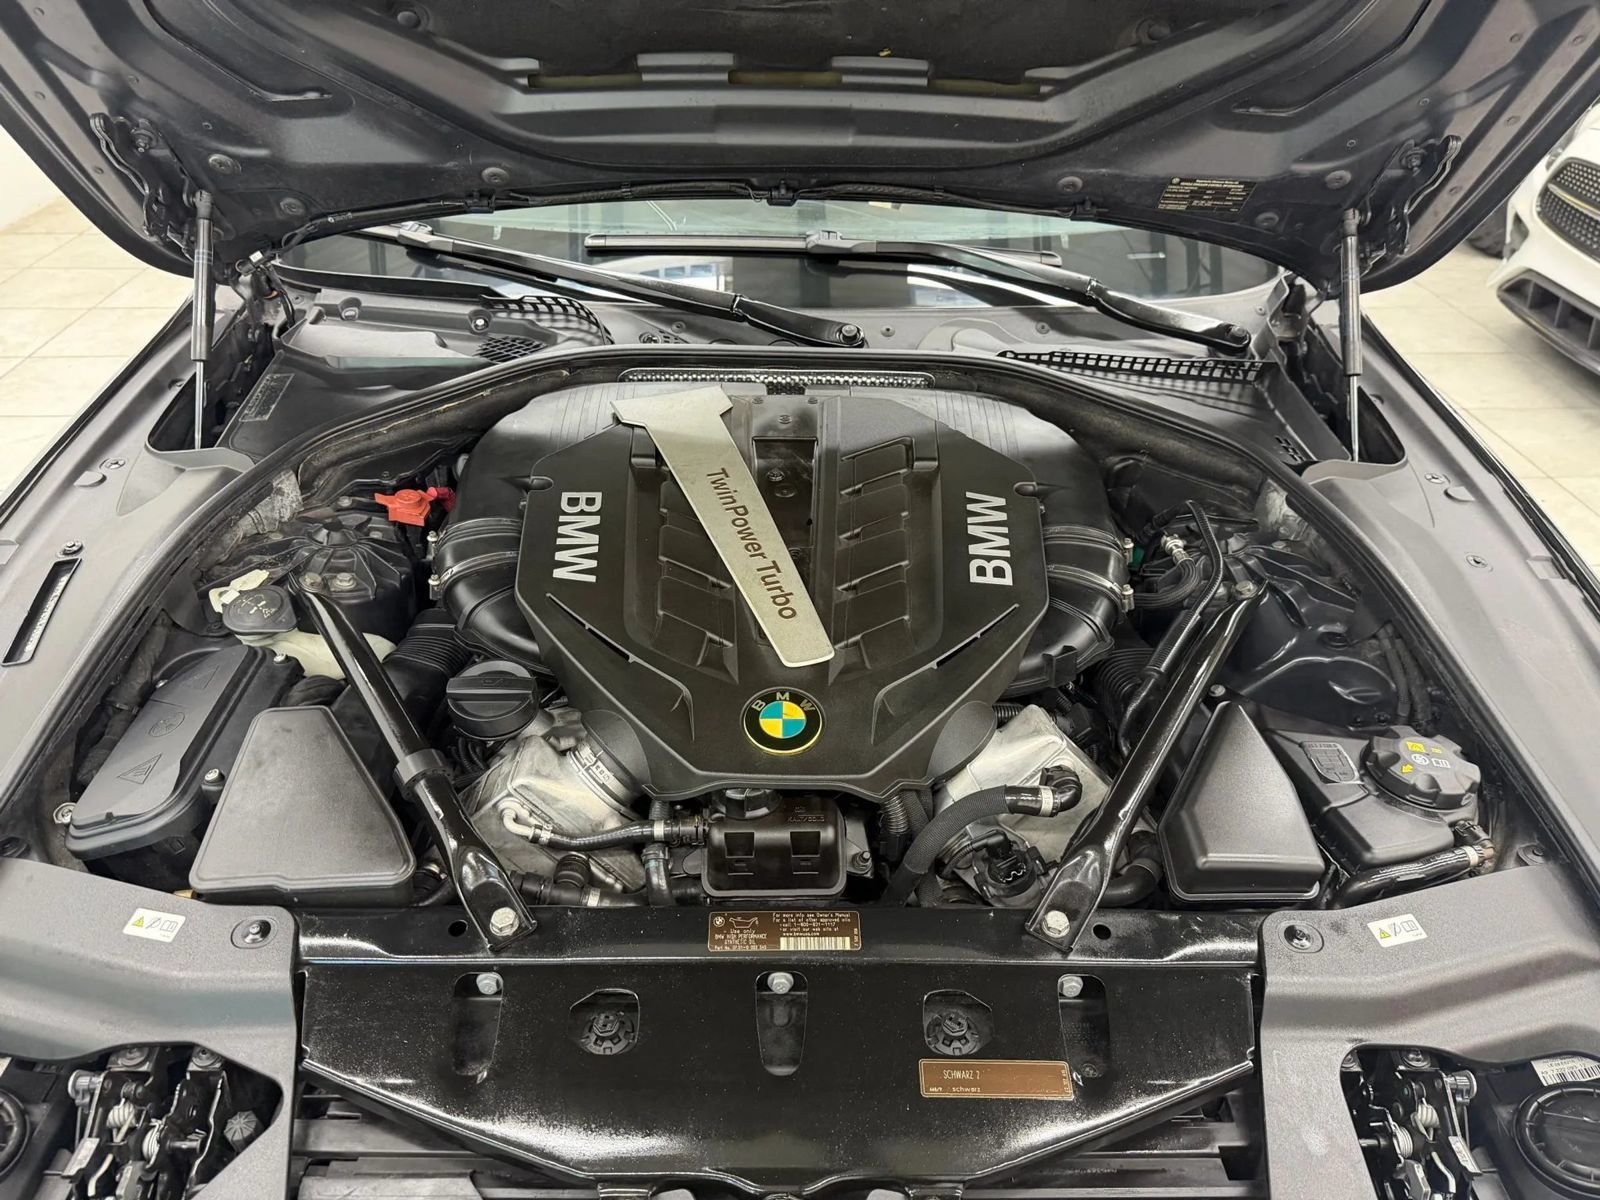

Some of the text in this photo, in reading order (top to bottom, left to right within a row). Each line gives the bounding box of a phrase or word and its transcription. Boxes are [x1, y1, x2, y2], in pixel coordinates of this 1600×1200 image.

[553, 491, 602, 582] BMW
[707, 468, 797, 620] TwinPower Turbo
[965, 491, 1013, 586] BMW
[752, 692, 815, 711] BMW
[943, 1069, 980, 1080] SCHWARZ 2
